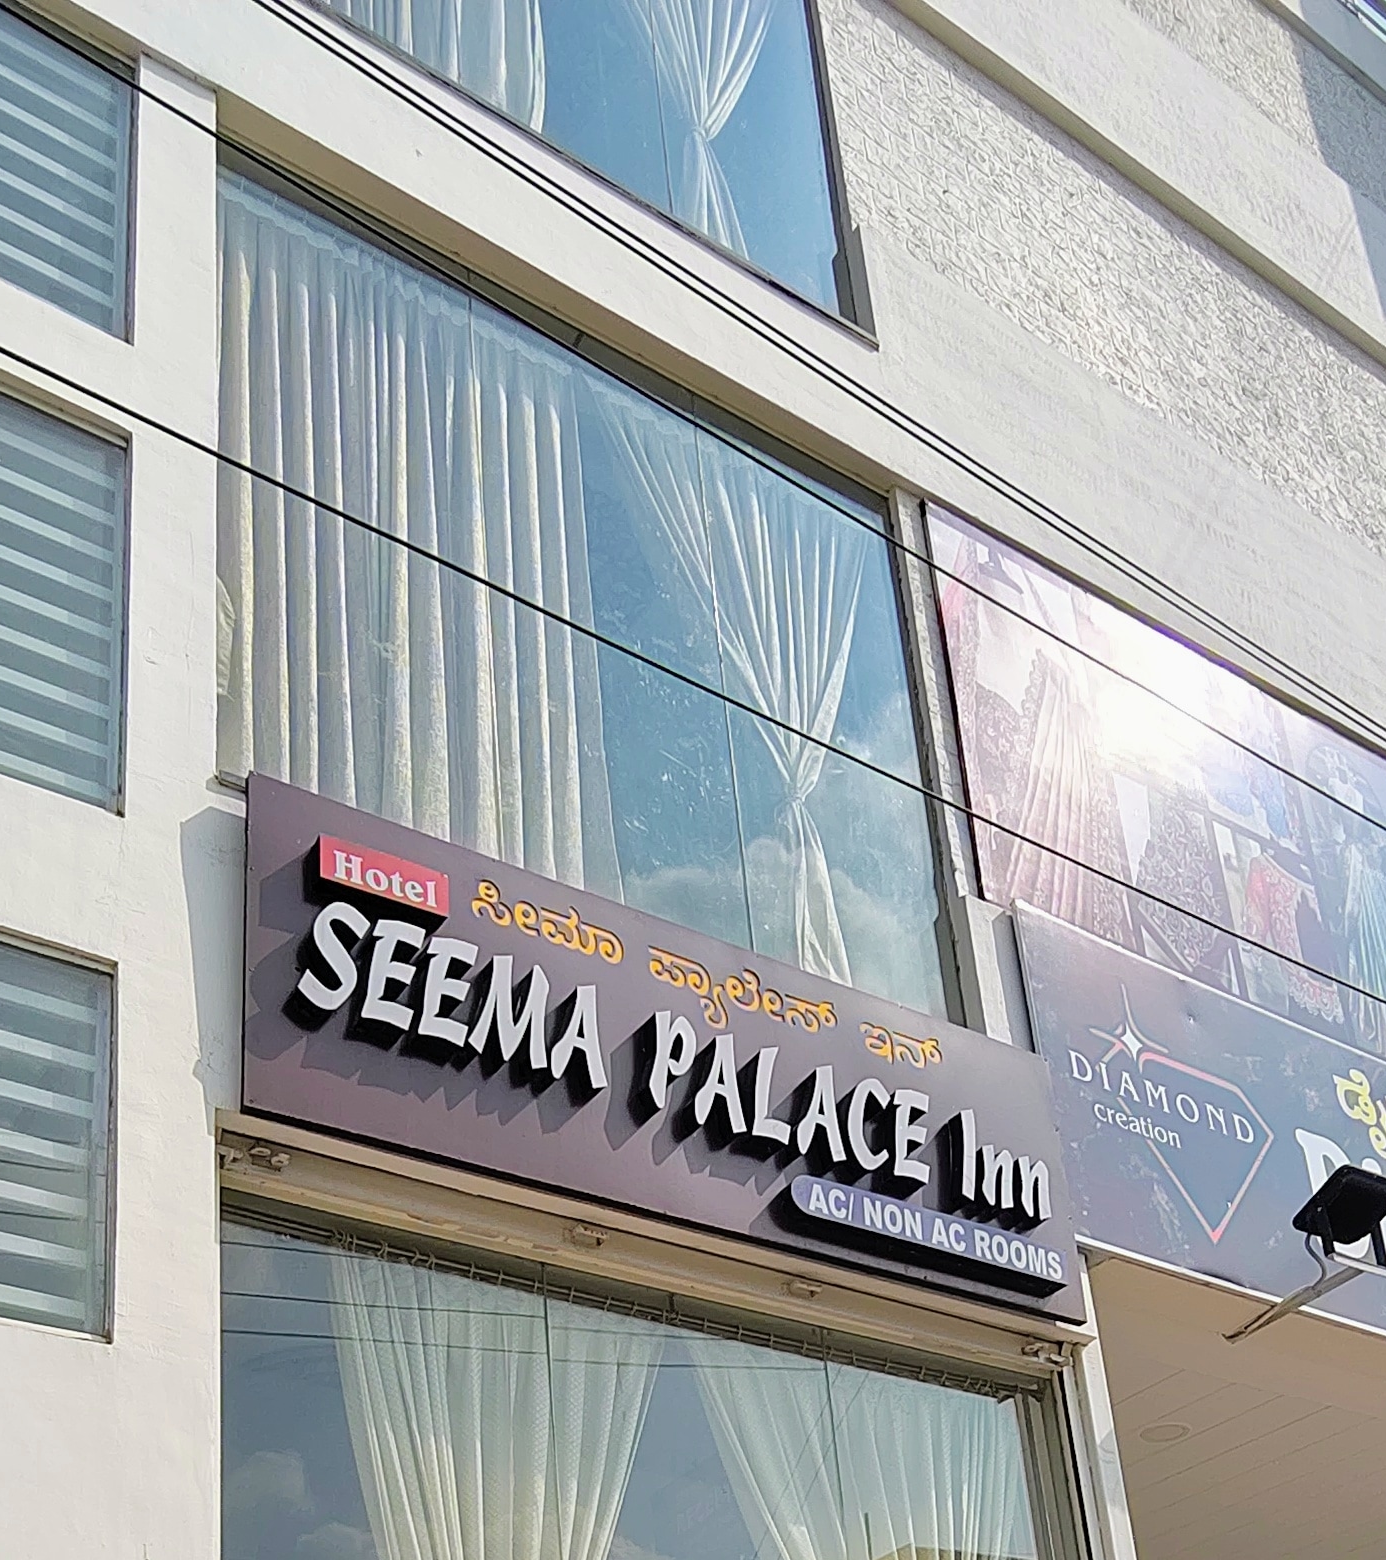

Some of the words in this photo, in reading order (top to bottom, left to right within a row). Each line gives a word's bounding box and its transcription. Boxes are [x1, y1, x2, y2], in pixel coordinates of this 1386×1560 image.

[331, 849, 439, 908] Hotel
[470, 878, 624, 965] ಸೀಮಾ
[858, 1020, 943, 1070] ಇನ್
[297, 900, 608, 1090] SEEMA
[649, 1008, 932, 1187] PALACE
[958, 1107, 1053, 1220] Inn
[1068, 1049, 1256, 1144] DIAMOND
[1093, 1103, 1183, 1149] creation
[807, 1183, 855, 1221] AC/
[863, 1196, 923, 1241] NON
[931, 1217, 967, 1252] AC
[973, 1229, 1064, 1281] ROOMS
